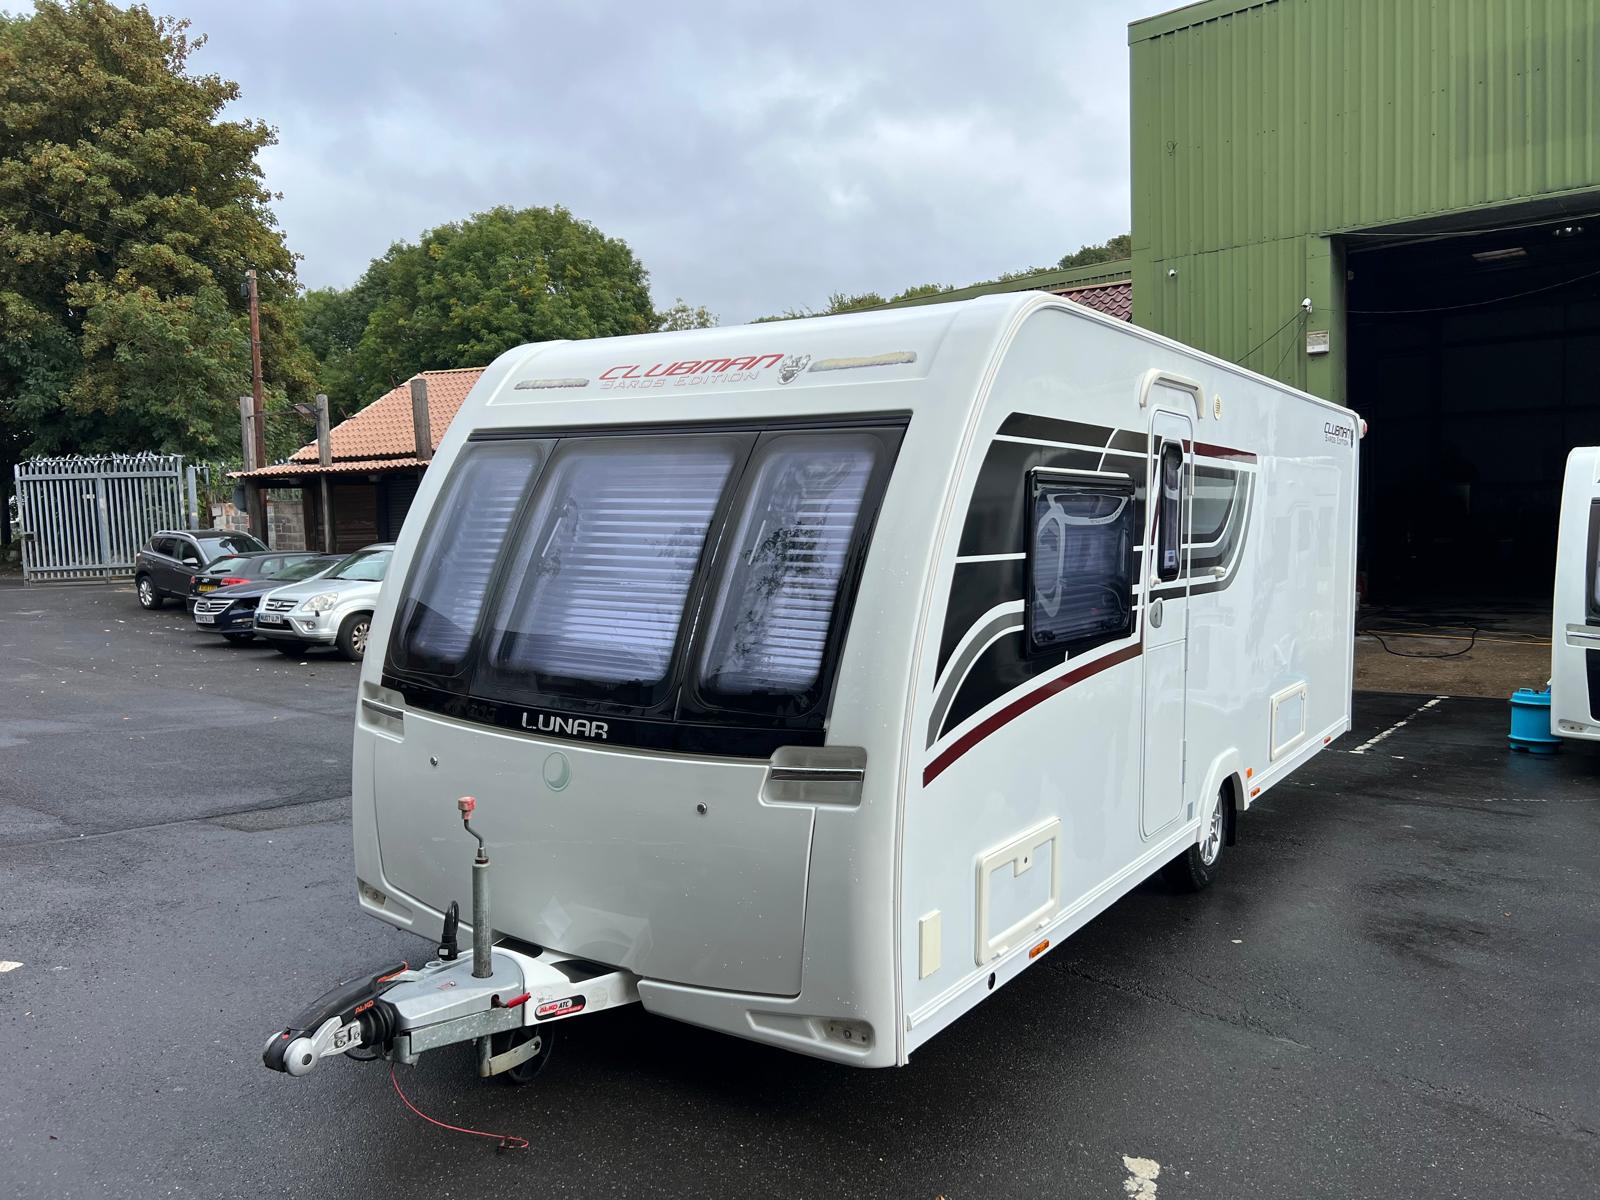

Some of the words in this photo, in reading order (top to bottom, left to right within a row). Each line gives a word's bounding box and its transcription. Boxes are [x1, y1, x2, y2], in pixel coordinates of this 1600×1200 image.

[599, 353, 784, 380] CLUBMAN
[600, 379, 666, 389] SAROS
[673, 371, 760, 386] EDITION
[521, 712, 609, 739] LUNAR
[558, 1000, 571, 1009] ATC
